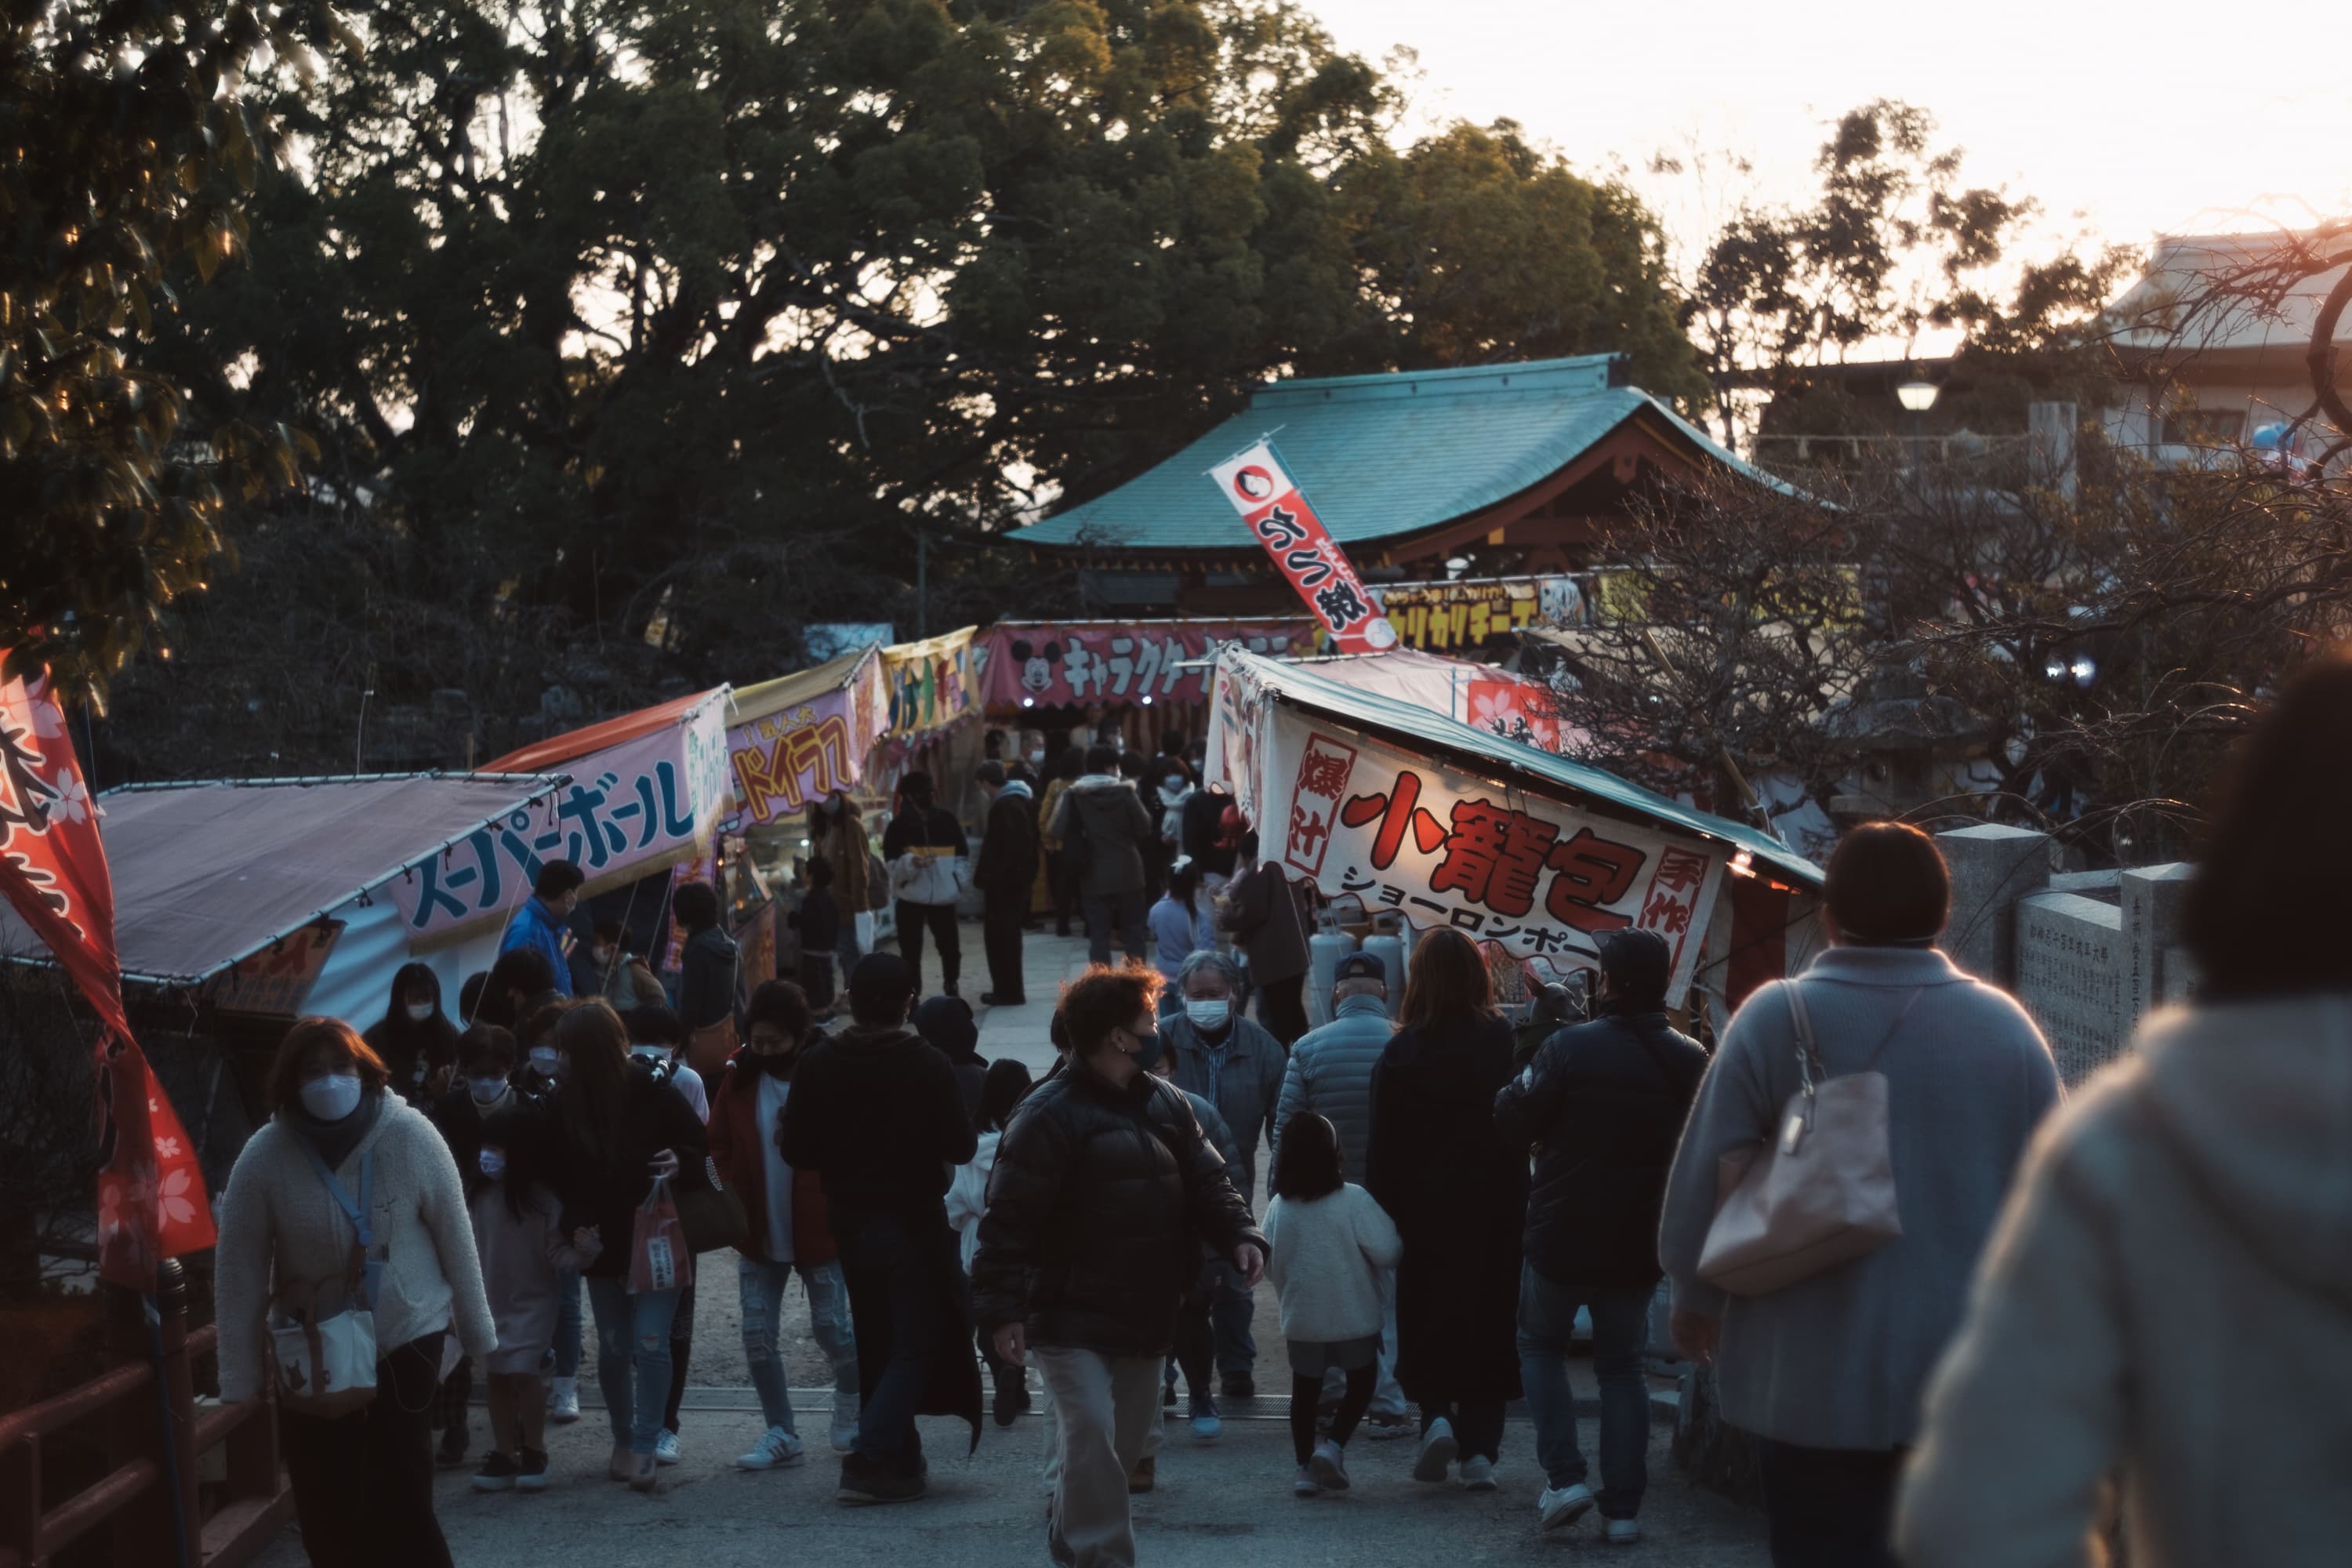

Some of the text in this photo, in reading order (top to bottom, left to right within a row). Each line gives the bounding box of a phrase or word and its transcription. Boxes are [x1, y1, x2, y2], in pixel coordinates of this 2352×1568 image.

[410, 760, 697, 930] スーパーボール
[1290, 748, 1350, 858] 爆汁
[1341, 771, 1646, 935] 小籠包
[1341, 866, 1602, 961] ショーロンポー
[1644, 851, 1701, 947] 手作
